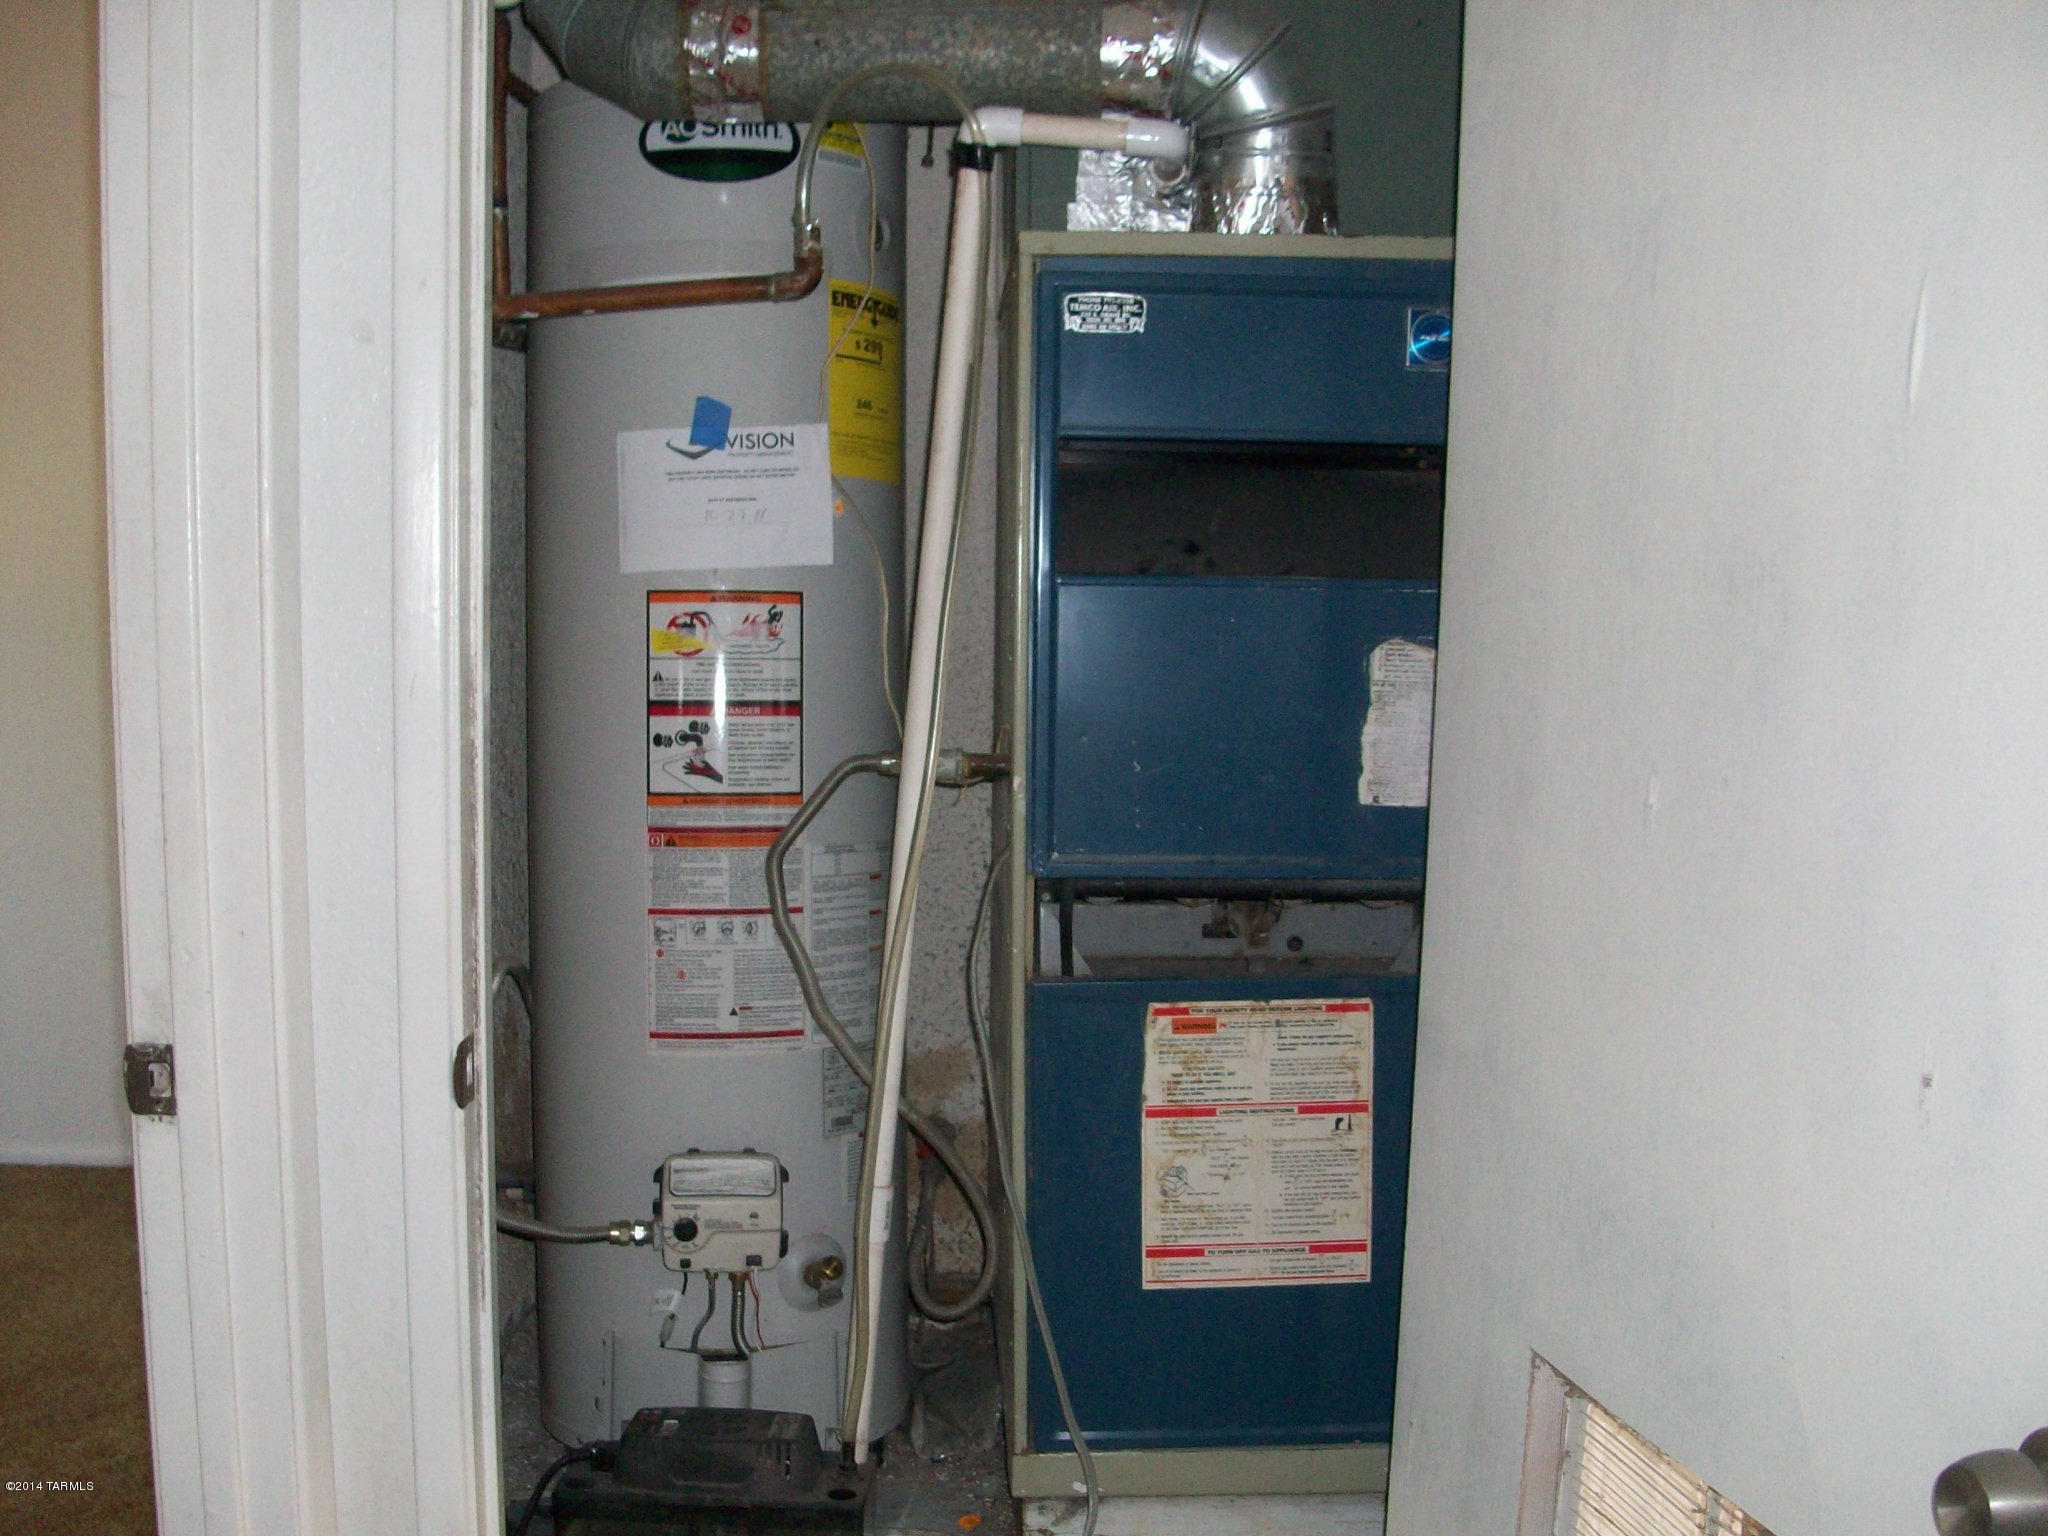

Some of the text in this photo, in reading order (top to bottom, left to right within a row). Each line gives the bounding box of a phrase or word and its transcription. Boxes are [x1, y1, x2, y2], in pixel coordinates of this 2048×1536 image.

[727, 431, 795, 450] VISION
[726, 706, 760, 715] ANGER
[1181, 1022, 1216, 1030] WARNING
